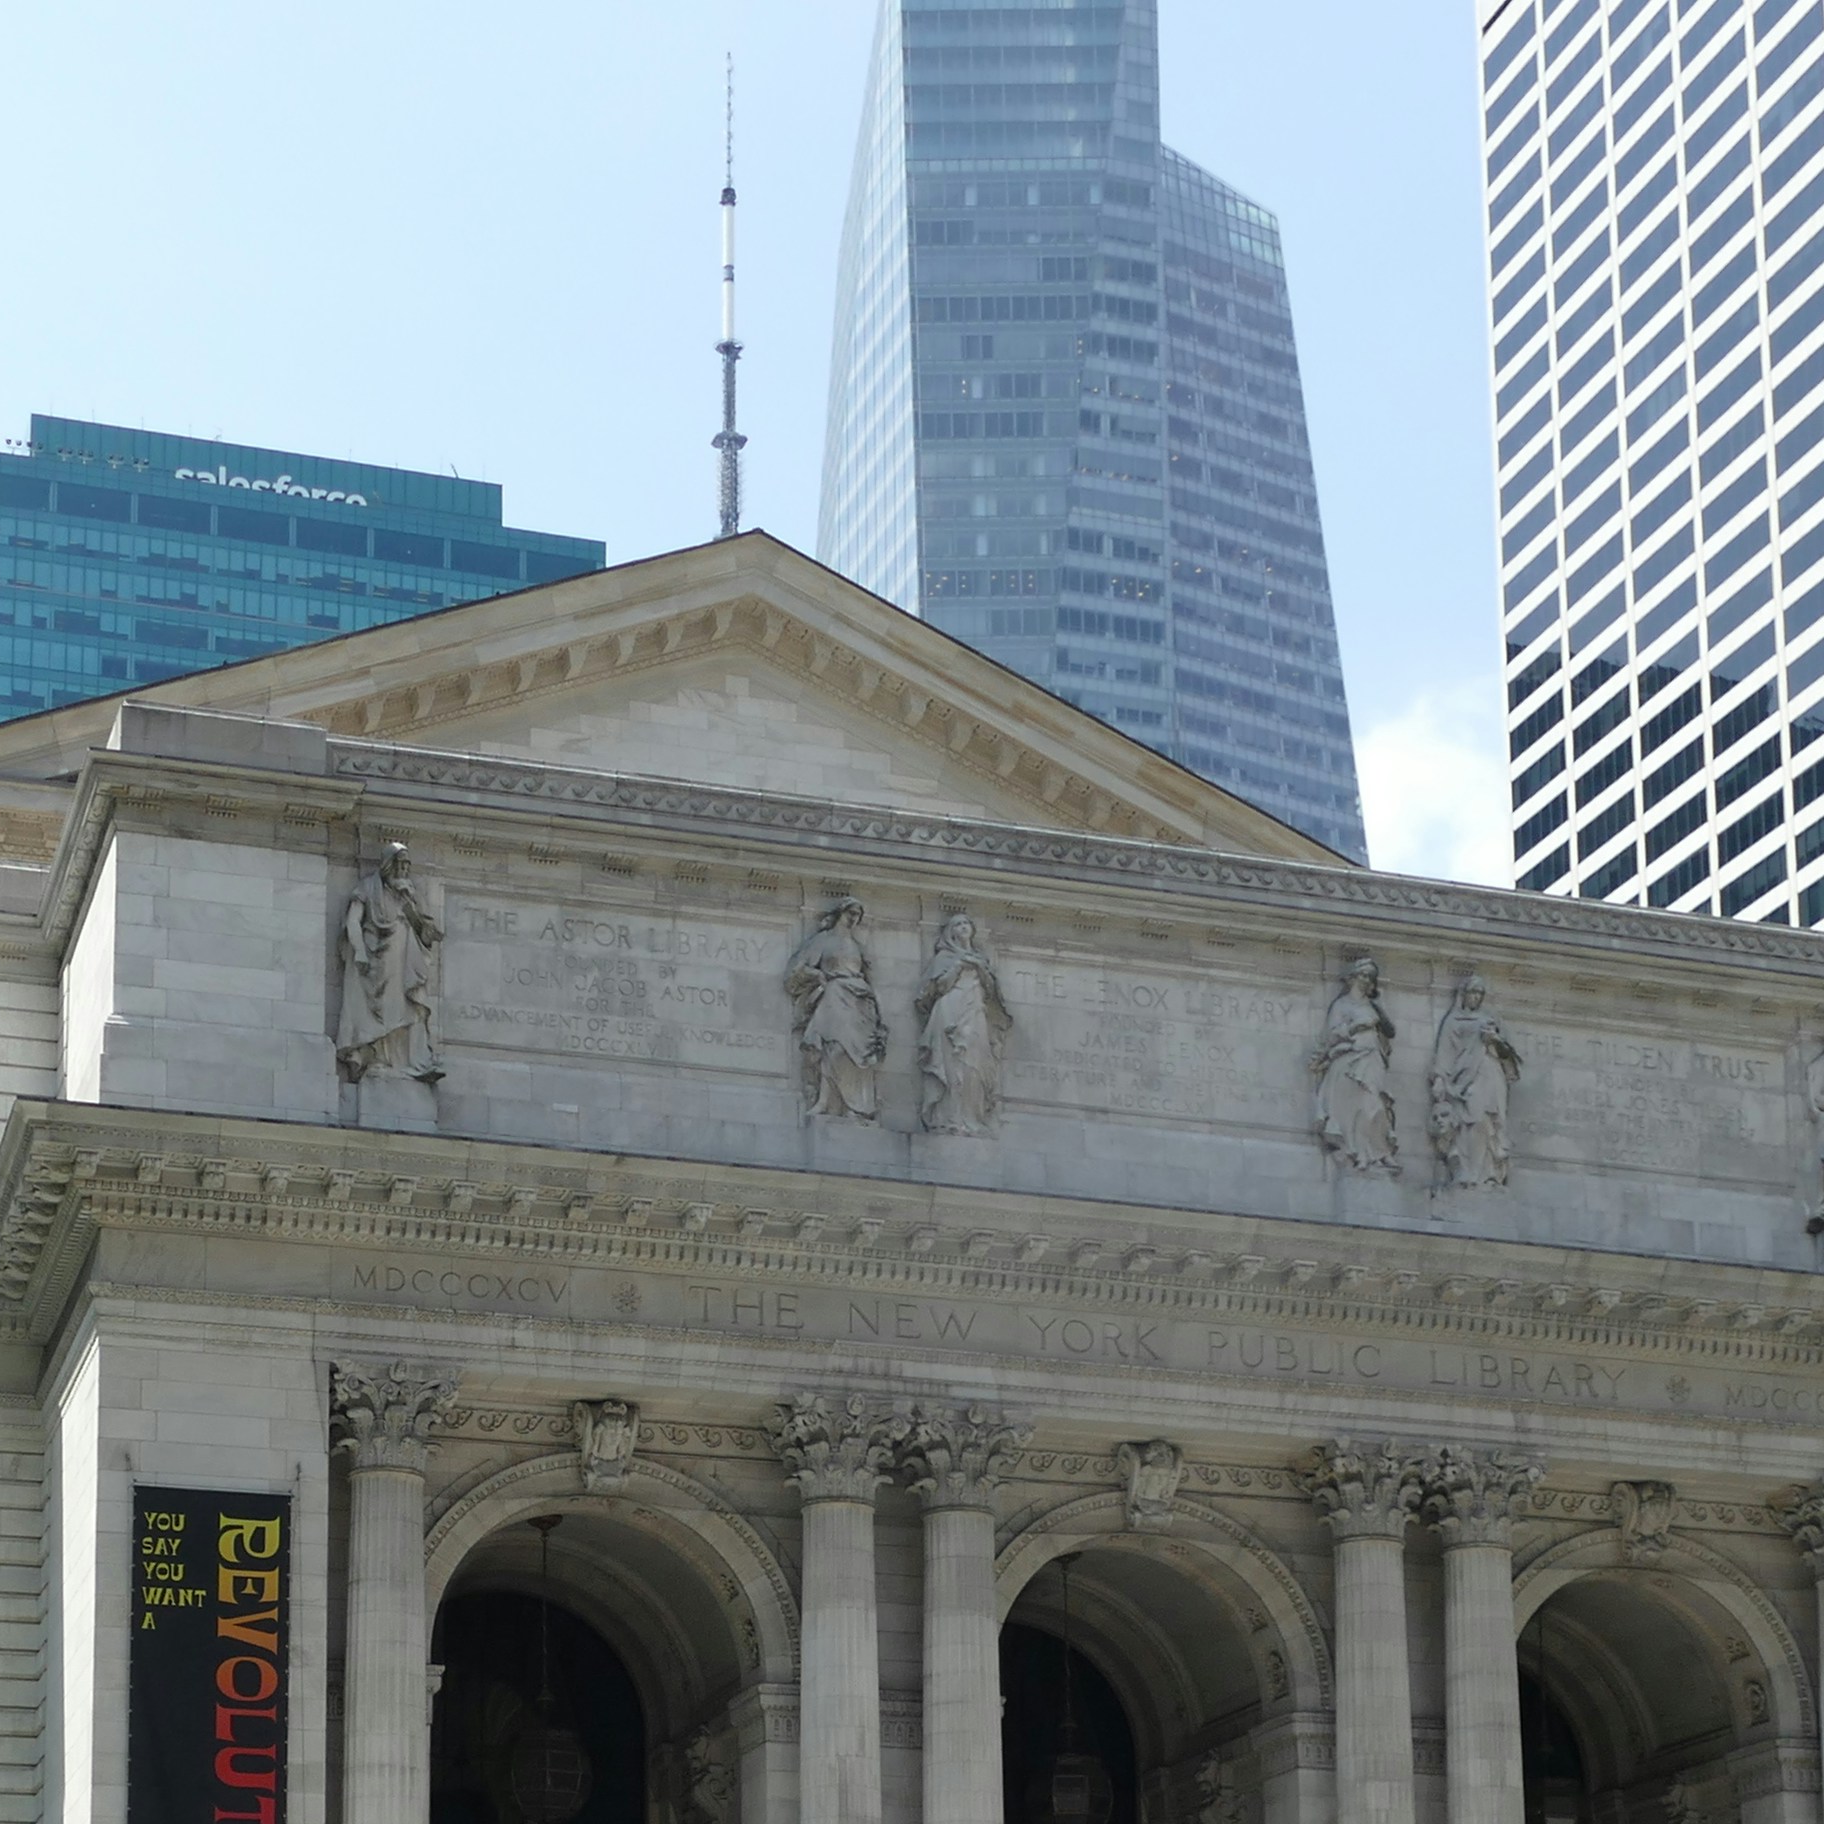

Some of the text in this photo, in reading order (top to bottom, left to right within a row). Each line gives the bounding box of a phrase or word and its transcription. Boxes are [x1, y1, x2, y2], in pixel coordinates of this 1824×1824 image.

[463, 906, 769, 963] THE ASTOR LIBRARY
[502, 966, 729, 1007] JOHN JACOB ASTOR
[657, 965, 678, 981] BY
[1015, 970, 1294, 1026] THE LENOX LIBRARY
[457, 1003, 583, 1031] ADVANCEMENT
[586, 1017, 609, 1033] OF
[679, 1026, 776, 1052] KNOWLEDGE
[1077, 1030, 1237, 1063] JAMES LENOX
[1586, 1038, 1675, 1074] TILDEN
[1694, 1051, 1770, 1084] TRUST
[353, 1264, 569, 1304] MDCCCXCV
[688, 1284, 805, 1331] THE
[848, 1300, 979, 1342] NEW
[1026, 1313, 1166, 1363] YORK
[1206, 1330, 1382, 1380] PUBLIC
[1428, 1348, 1628, 1402] LIBRARY
[143, 1511, 186, 1532] YOU
[142, 1536, 182, 1556] SAY
[142, 1561, 185, 1582] YOU
[141, 1586, 207, 1608] WANT
[141, 1611, 156, 1630] A
